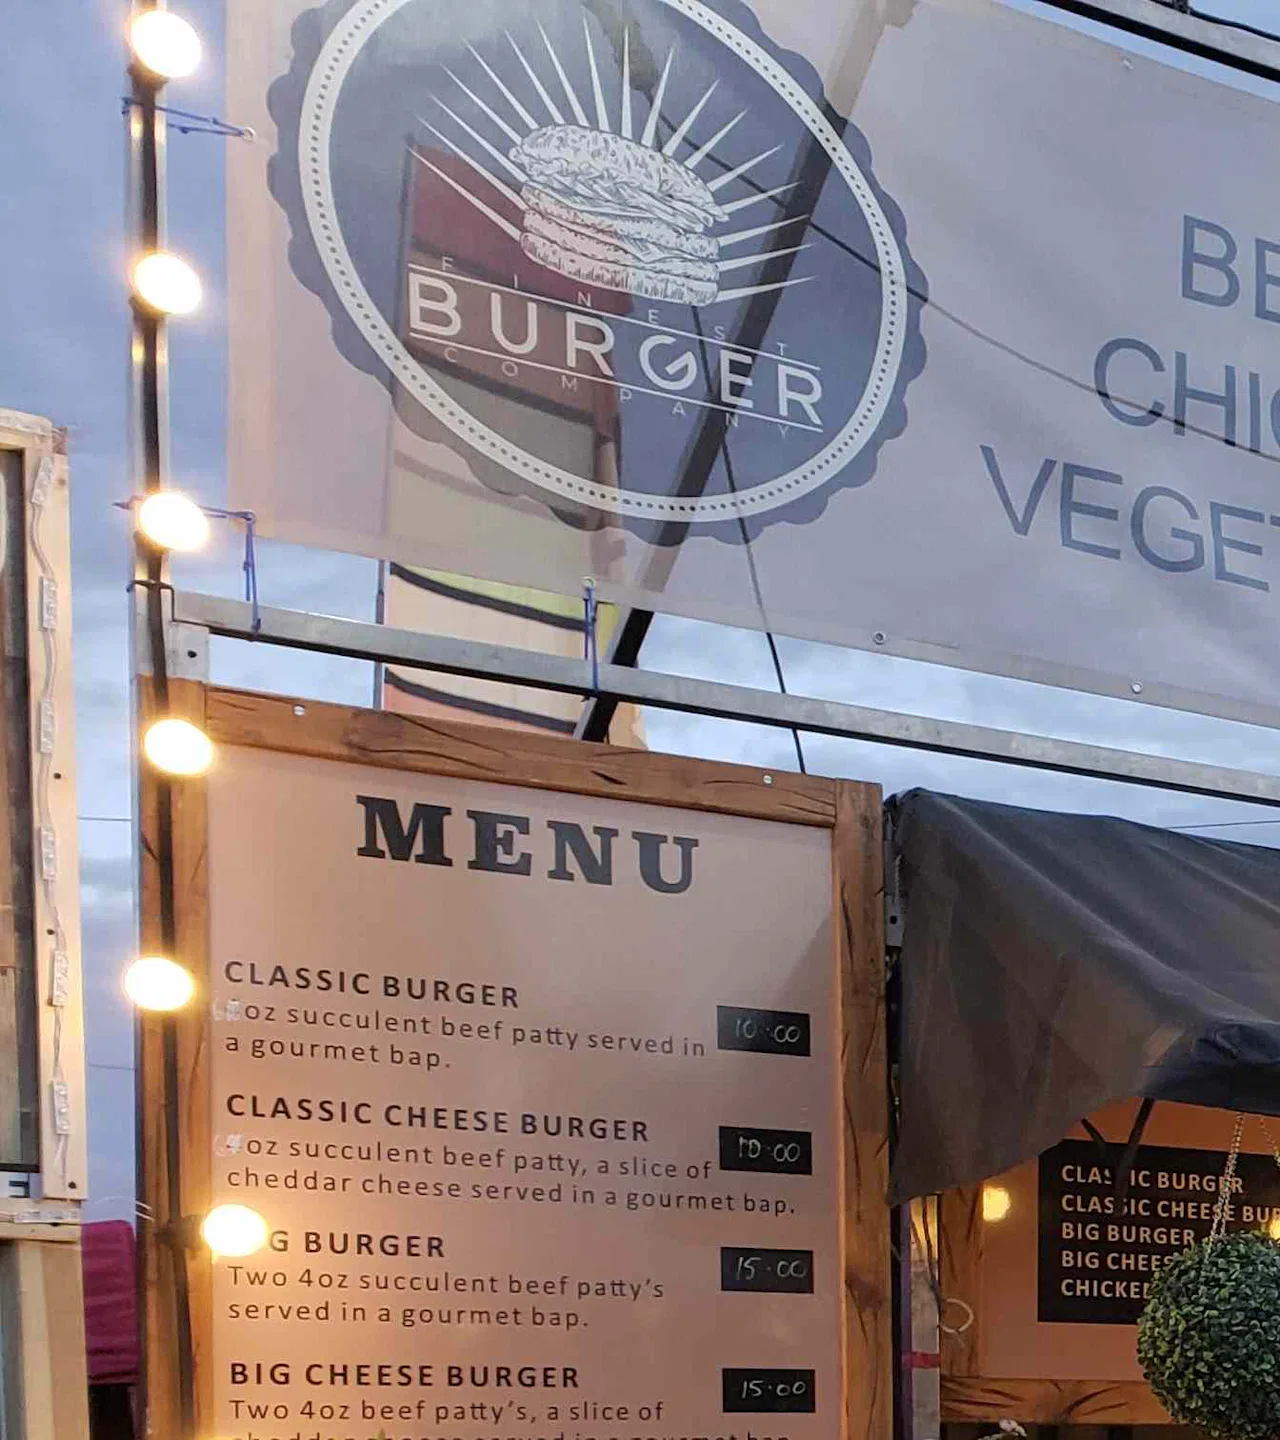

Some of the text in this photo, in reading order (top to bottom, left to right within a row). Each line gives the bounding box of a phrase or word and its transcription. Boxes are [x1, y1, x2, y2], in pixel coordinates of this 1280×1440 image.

[407, 270, 824, 428] BURGER
[355, 793, 699, 895] MENU
[225, 960, 520, 1009] CLASSIC BURGER
[287, 1005, 706, 1058] succulent beef patty served in
[225, 1036, 451, 1072] a gourmet bap.
[226, 1094, 650, 1144] CLASSIC CHEESE BURGER
[289, 1141, 712, 1181] succulent beef patty, a slice of
[227, 1167, 796, 1217] cheddar cheese served in a gourmet bap.
[1157, 1170, 1244, 1195] BURGER
[1157, 1200, 1236, 1223] CHEESE
[303, 1231, 447, 1260] BURGER
[1061, 1222, 1195, 1246] BIG BURGER
[228, 1266, 665, 1302] Two 4oz succulent beef patty's
[230, 1362, 581, 1389] BIG CHEESE BURGER
